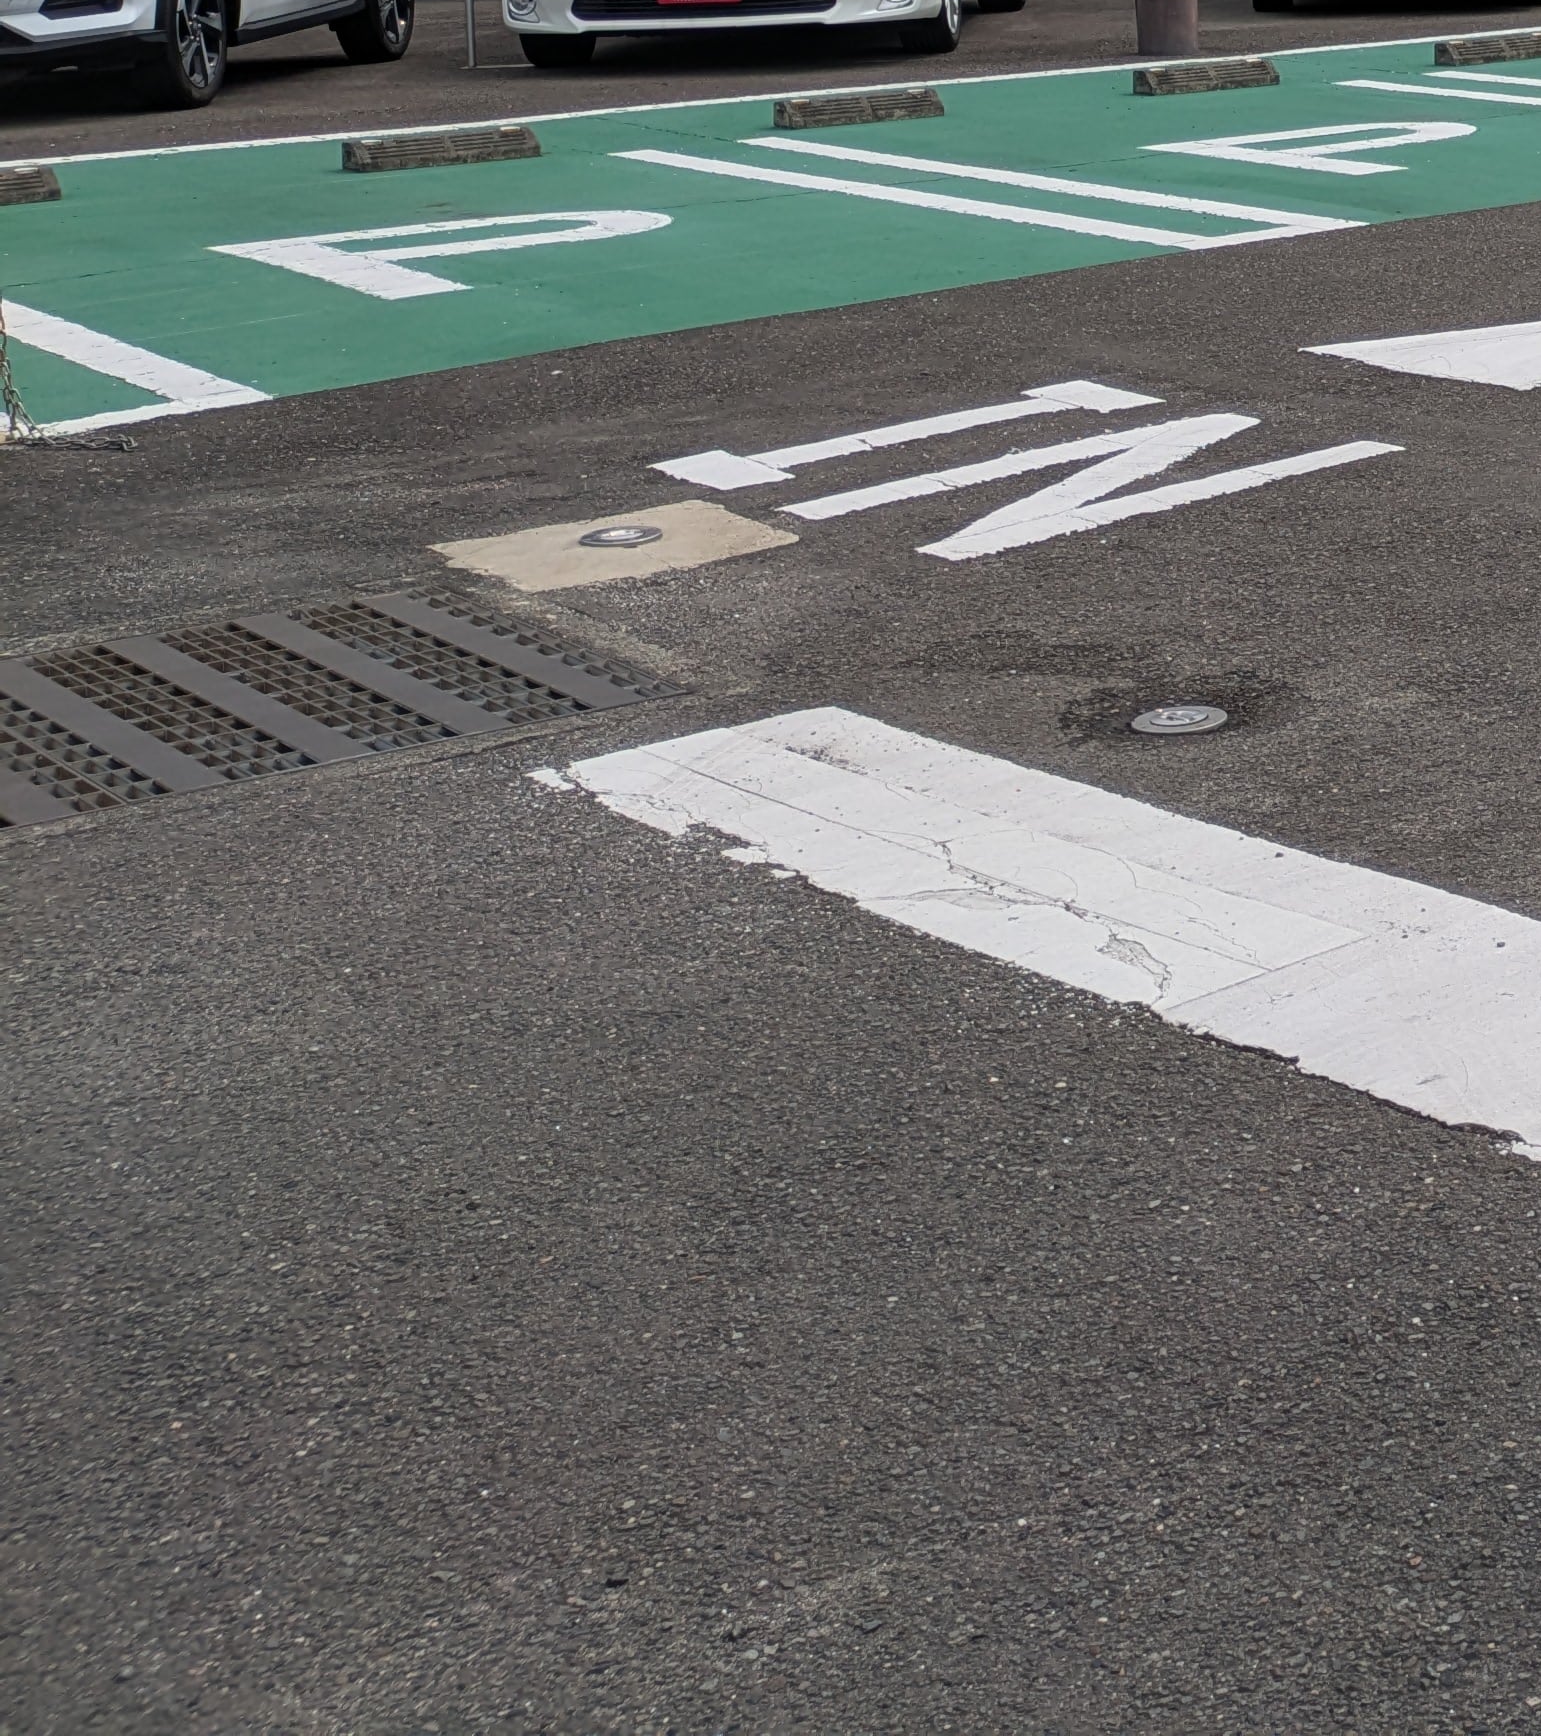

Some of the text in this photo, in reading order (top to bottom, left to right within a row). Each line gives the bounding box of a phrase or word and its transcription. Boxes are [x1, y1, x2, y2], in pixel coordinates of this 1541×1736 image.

[1139, 120, 1477, 175] P
[207, 209, 674, 300] P
[651, 380, 1405, 560] IN
